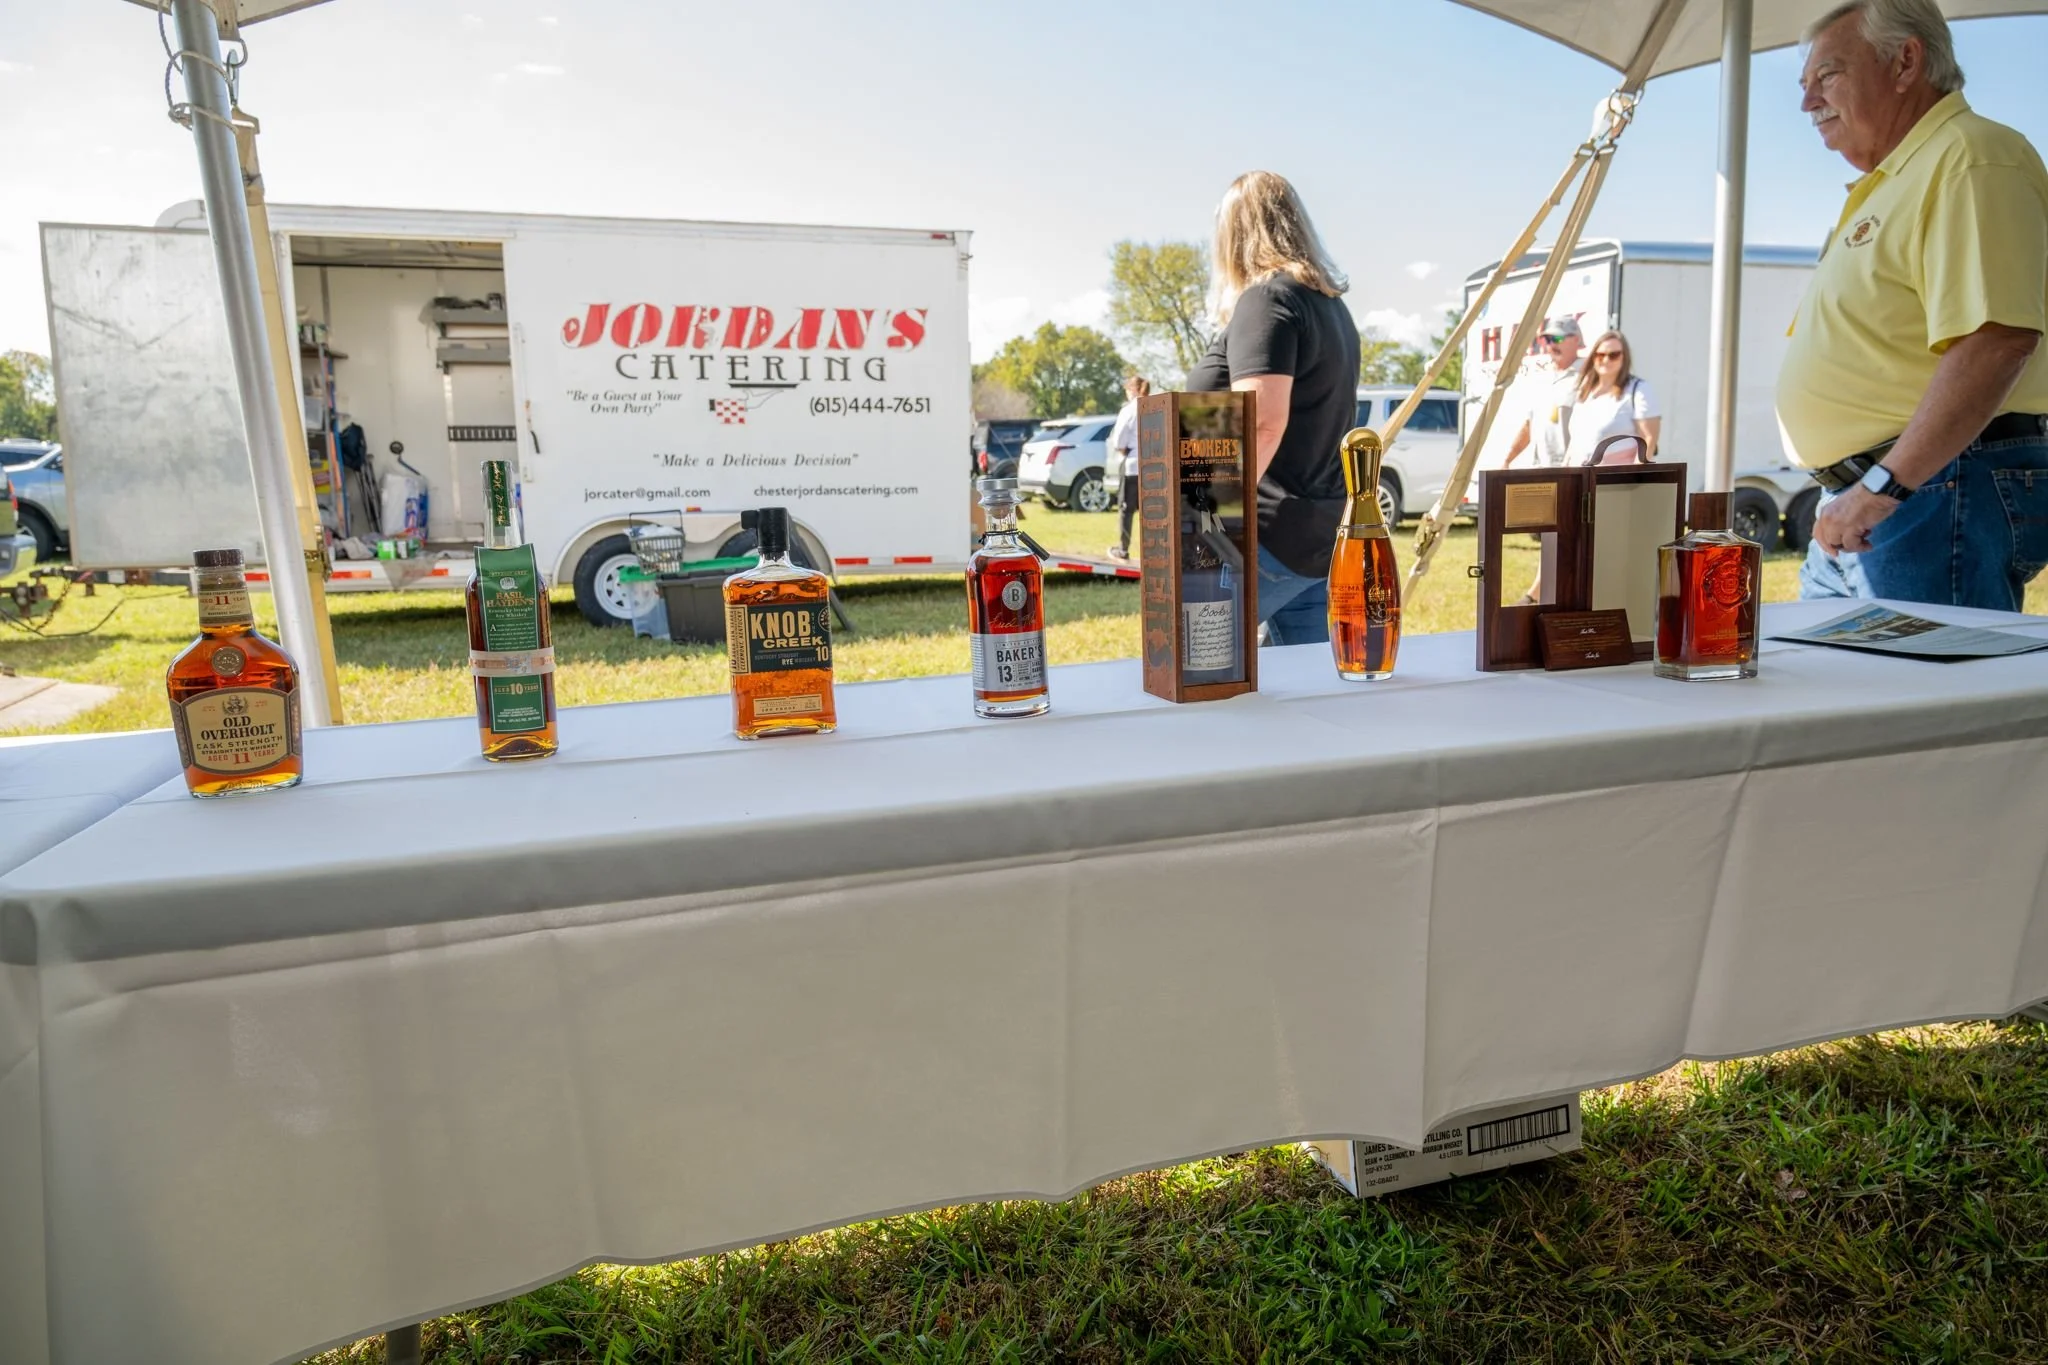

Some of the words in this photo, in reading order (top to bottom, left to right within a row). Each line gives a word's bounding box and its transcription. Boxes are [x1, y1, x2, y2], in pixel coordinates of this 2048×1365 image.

[561, 302, 929, 352] JORDAN'S
[615, 353, 886, 382] CATERING
[566, 389, 588, 401] "Be
[591, 392, 600, 401] a
[603, 389, 638, 401] Guest
[640, 390, 652, 401] at
[656, 390, 682, 401] Your
[590, 402, 619, 414] Own
[623, 401, 662, 417] Party"
[809, 396, 931, 416] (615)444-7651
[706, 456, 715, 467] a
[722, 452, 787, 467] Delicious
[794, 452, 860, 467] Decision"
[584, 486, 711, 502] jorcater@gmail.com
[753, 484, 919, 500] chesterjordanscatering.com
[215, 595, 231, 605] 11
[495, 591, 525, 600] BASIL
[1012, 588, 1020, 602] B
[750, 610, 811, 640] KNOB
[763, 636, 824, 649] CREEK
[815, 646, 829, 662] 10
[996, 645, 1043, 663] BAKER'S
[781, 658, 794, 666] RYE
[997, 665, 1013, 683] 13
[510, 682, 524, 696] 10
[223, 715, 252, 728] OLD
[200, 723, 276, 740] OVERHOLT
[196, 742, 224, 750] CASK
[227, 735, 283, 748] STRENGTH
[250, 743, 279, 751] WHISKEY
[207, 754, 229, 762] AGED
[232, 752, 252, 765] 11
[253, 749, 277, 758] YEARS
[1451, 1128, 1463, 1138] CO.
[1364, 1143, 1386, 1156] JAMES
[1443, 1140, 1463, 1150] WHISKEY
